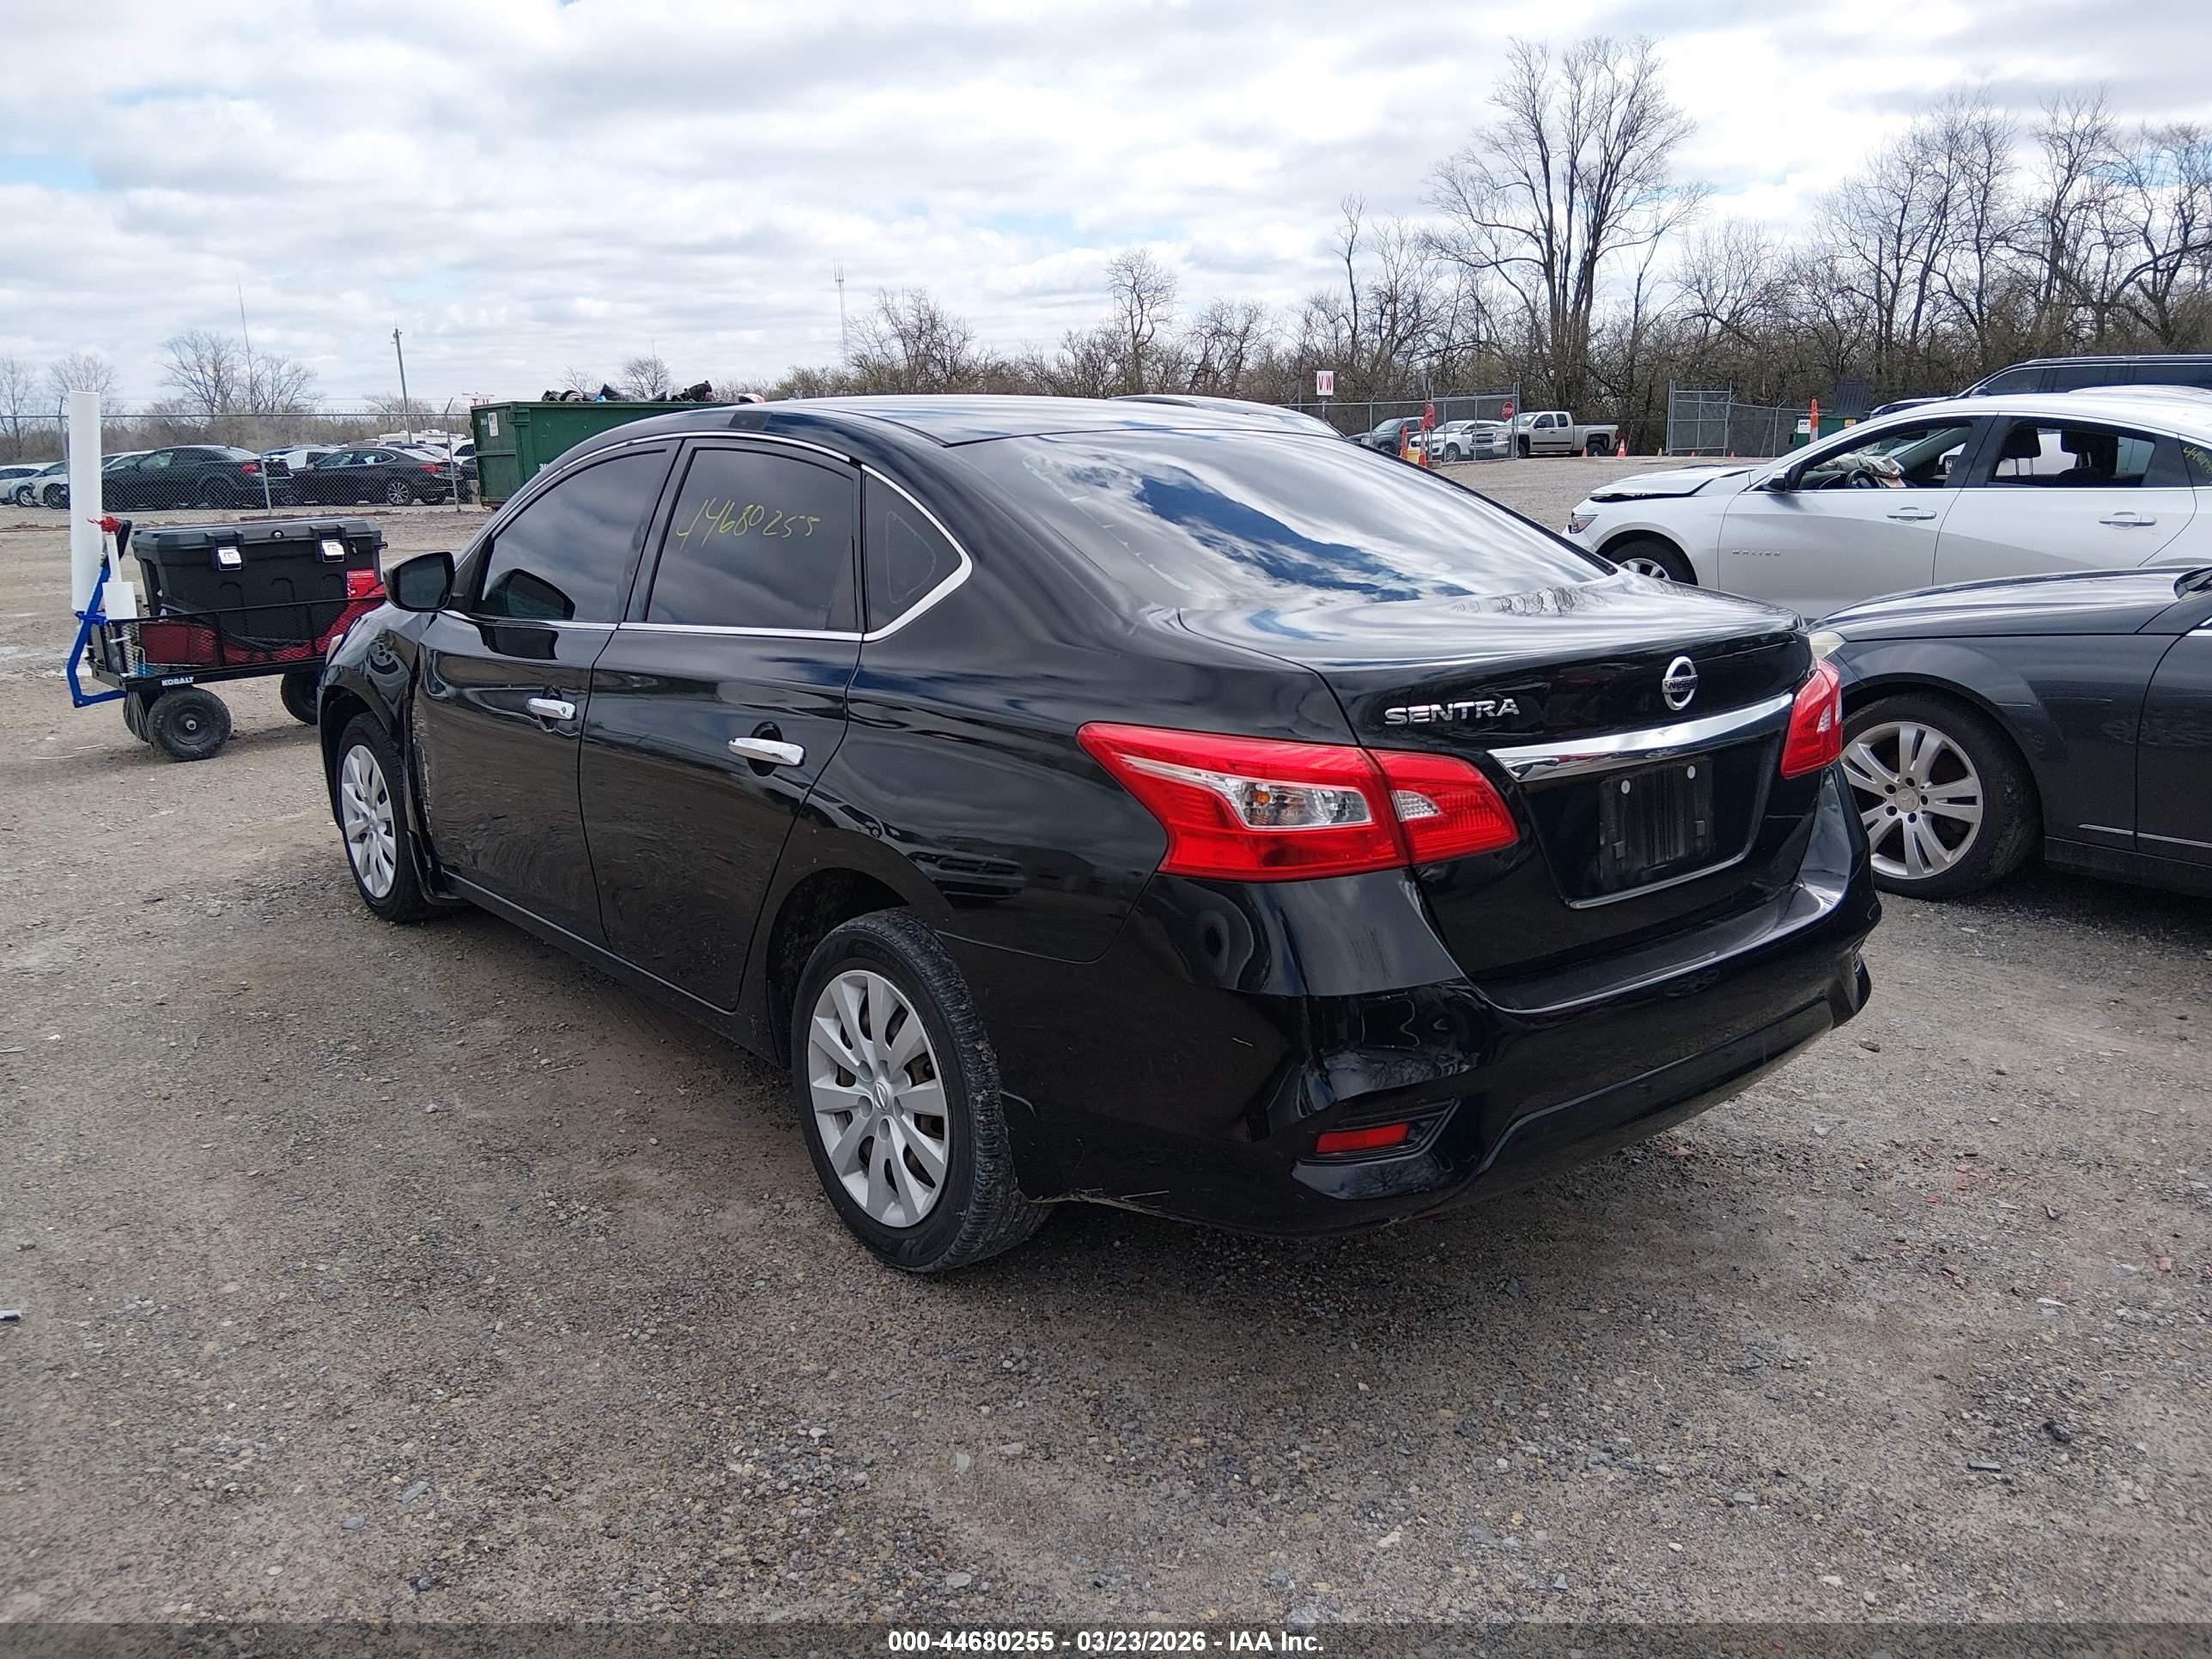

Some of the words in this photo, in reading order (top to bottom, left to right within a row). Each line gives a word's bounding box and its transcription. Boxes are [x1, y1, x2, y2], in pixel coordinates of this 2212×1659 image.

[676, 497, 821, 550] 44680255
[161, 676, 194, 686] KOBALT
[1384, 698, 1520, 725] SENTRA
